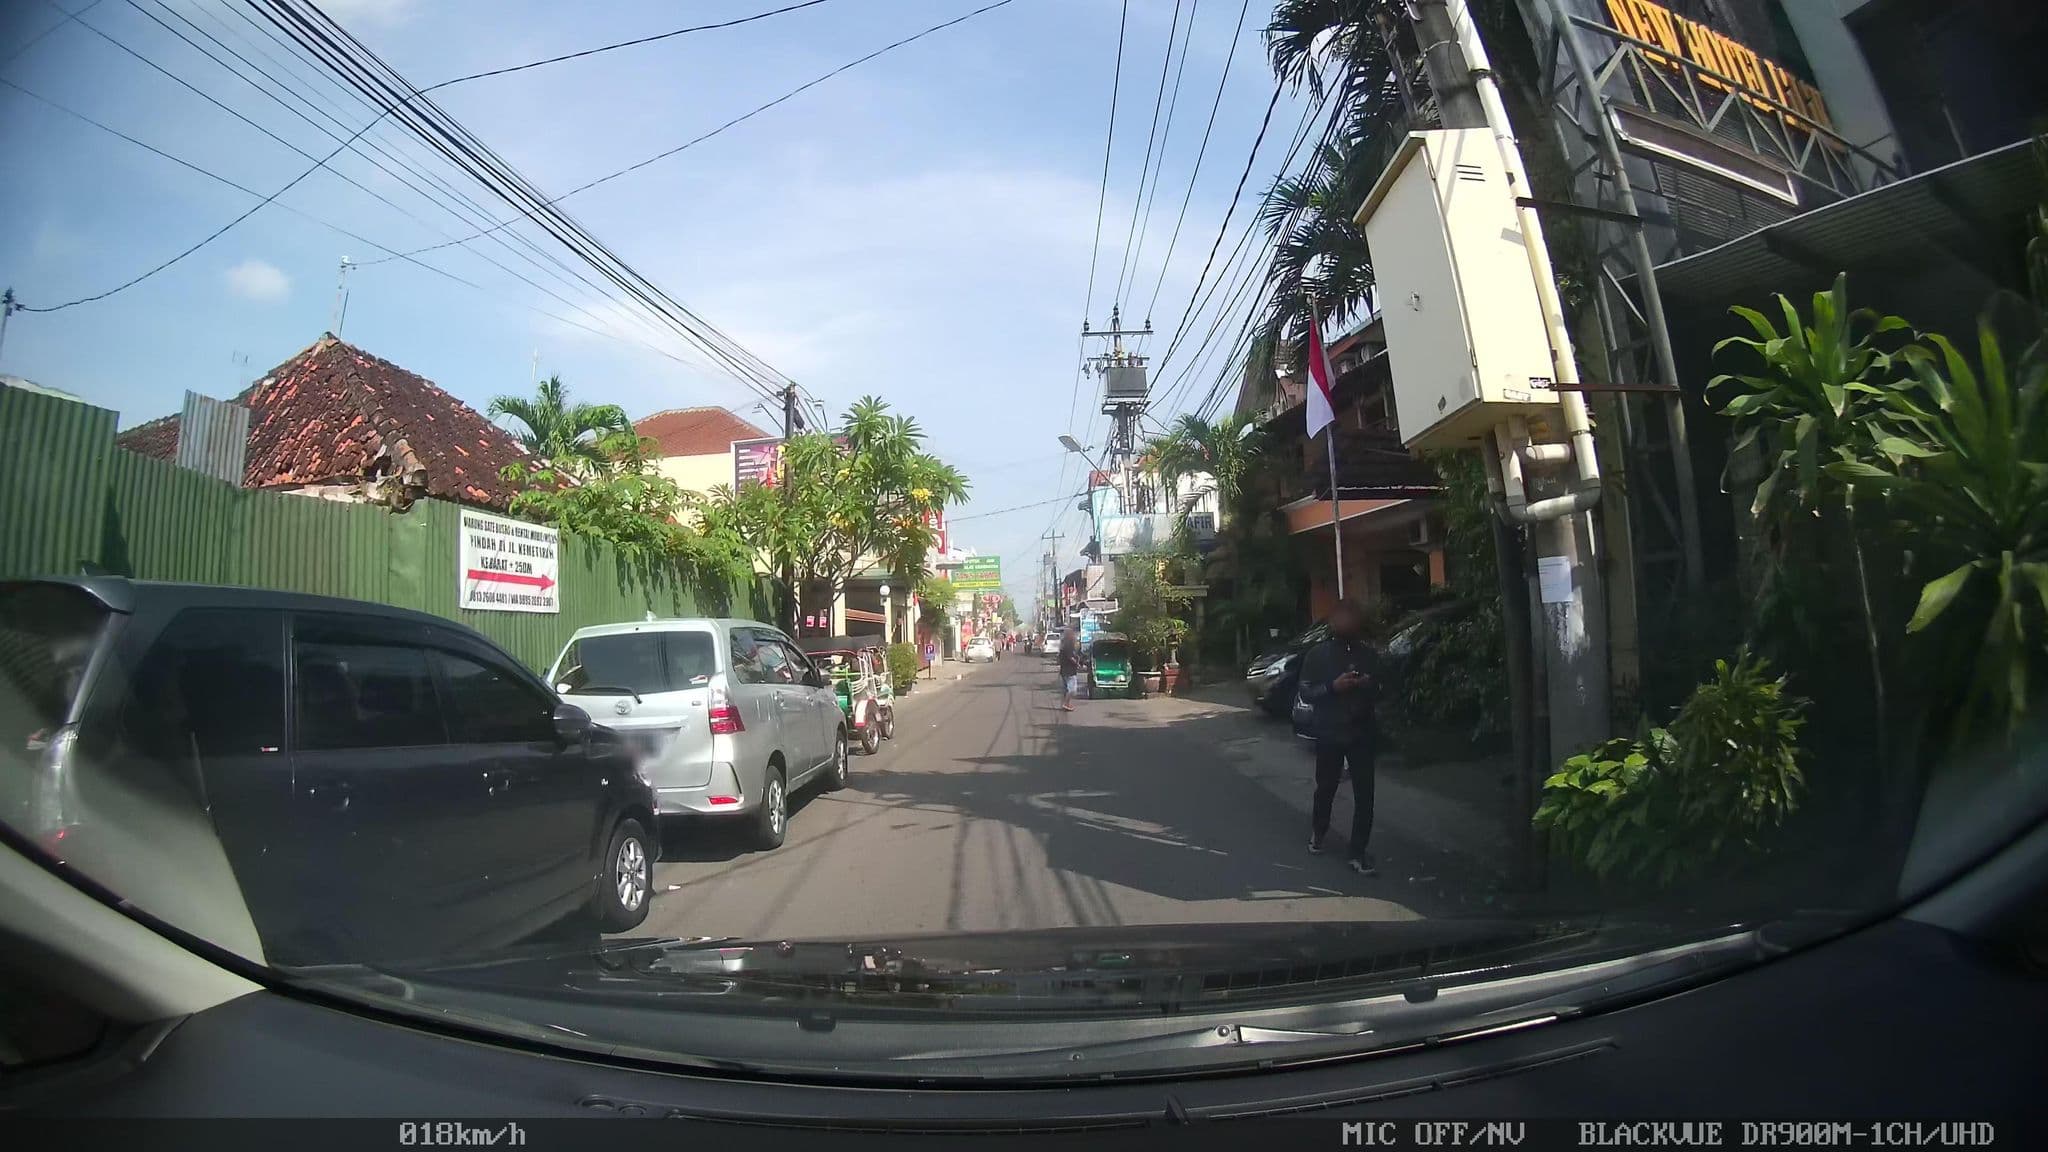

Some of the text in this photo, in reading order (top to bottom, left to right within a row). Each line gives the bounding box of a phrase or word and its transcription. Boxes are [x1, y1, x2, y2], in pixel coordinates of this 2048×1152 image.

[1606, 0, 1682, 69] NEW
[1674, 13, 1777, 113] HOTEL
[1187, 516, 1212, 528] AFIR
[470, 534, 496, 551] PINDAH
[515, 561, 533, 575] 250M
